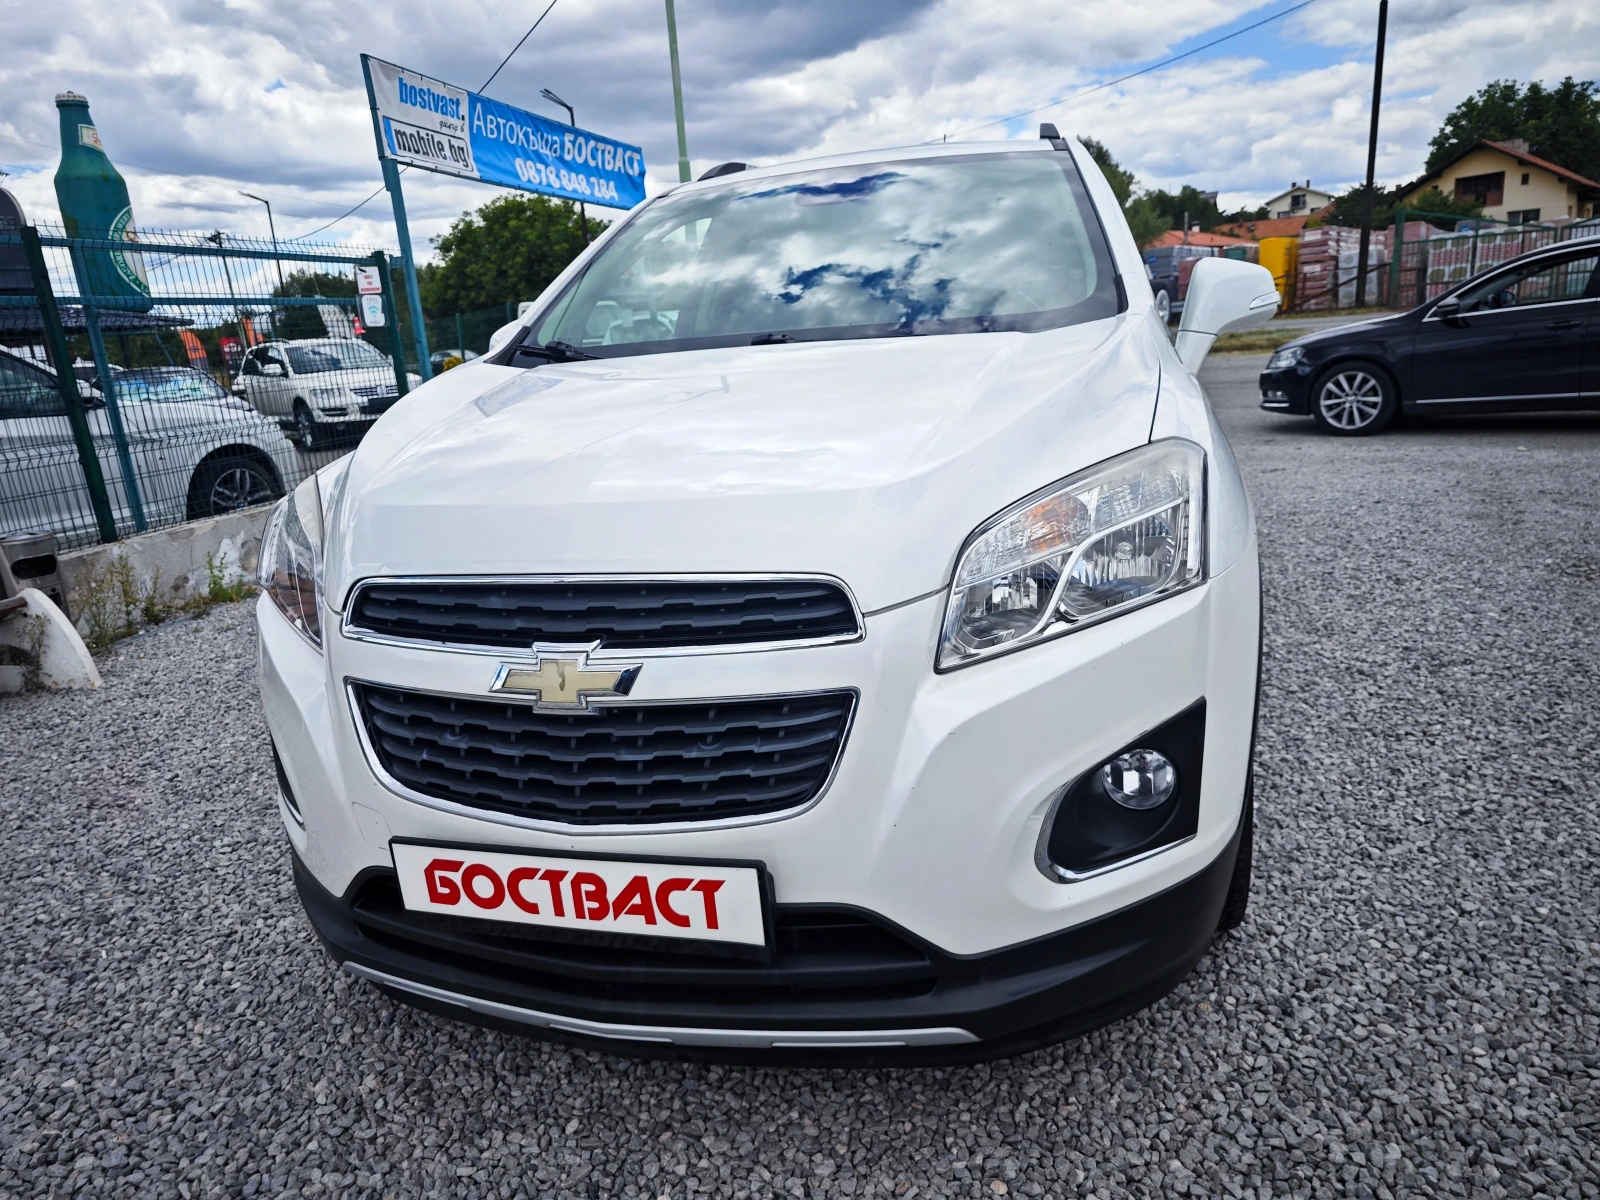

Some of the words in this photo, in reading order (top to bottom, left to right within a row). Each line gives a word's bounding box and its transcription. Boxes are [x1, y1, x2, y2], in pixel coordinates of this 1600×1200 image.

[398, 77, 465, 121] bostvast.
[394, 128, 469, 168] mobile.bg
[473, 103, 560, 162] Автокъща
[564, 132, 641, 177] БОСТВАСТ
[514, 157, 561, 189] 0878
[560, 169, 591, 196] 848
[589, 176, 619, 201] 284
[423, 858, 726, 930] БОСТВАСТ
